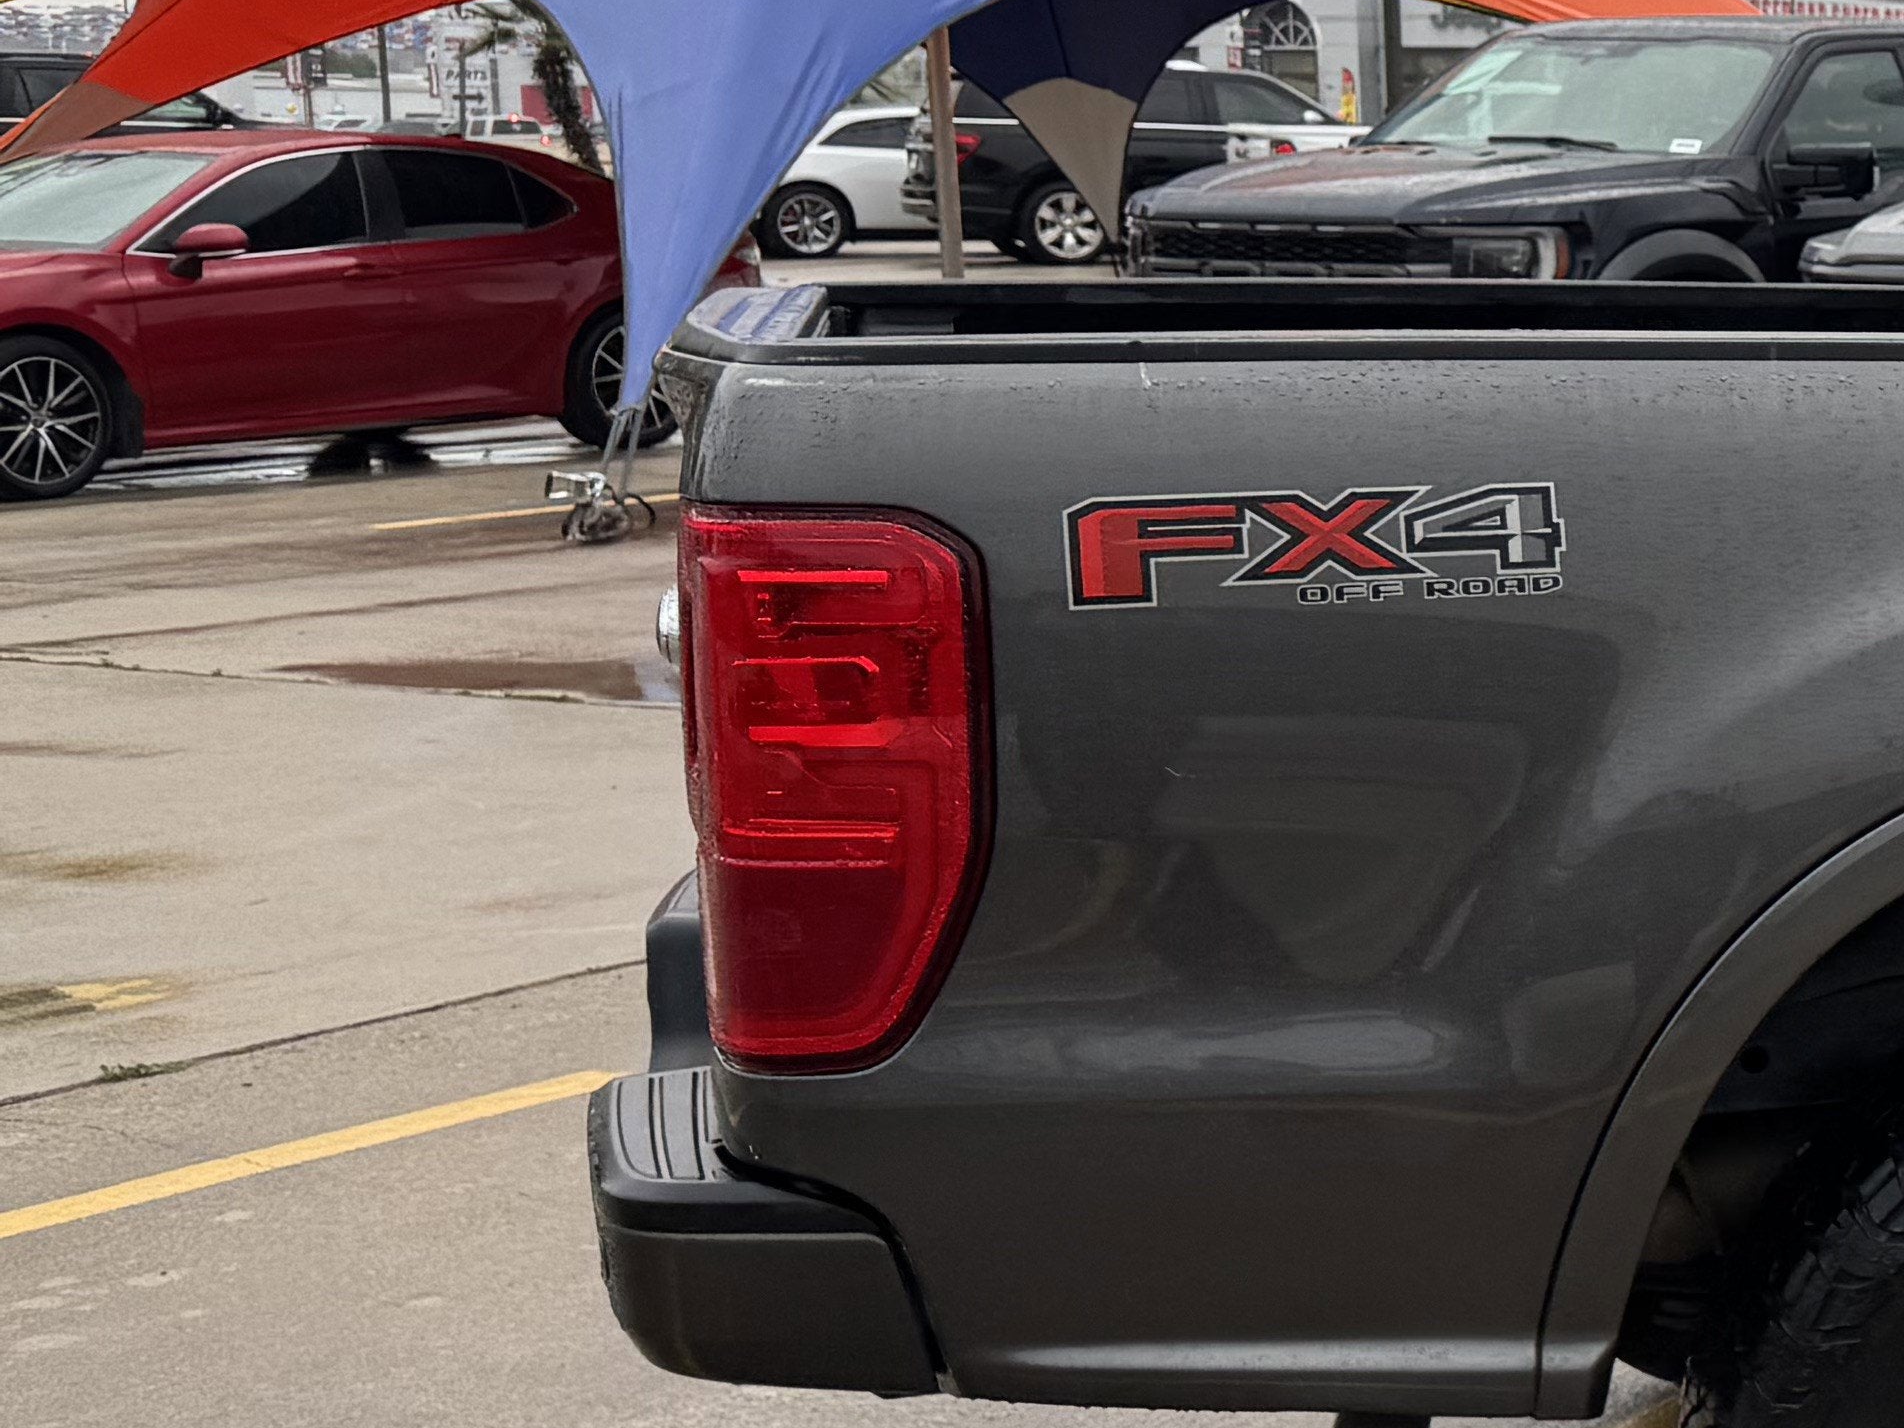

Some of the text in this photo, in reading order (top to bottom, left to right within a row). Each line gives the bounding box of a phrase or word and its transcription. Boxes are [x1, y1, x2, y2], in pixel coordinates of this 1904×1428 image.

[1062, 482, 1566, 610] FX4
[1298, 573, 1565, 605] OFF ROAD
